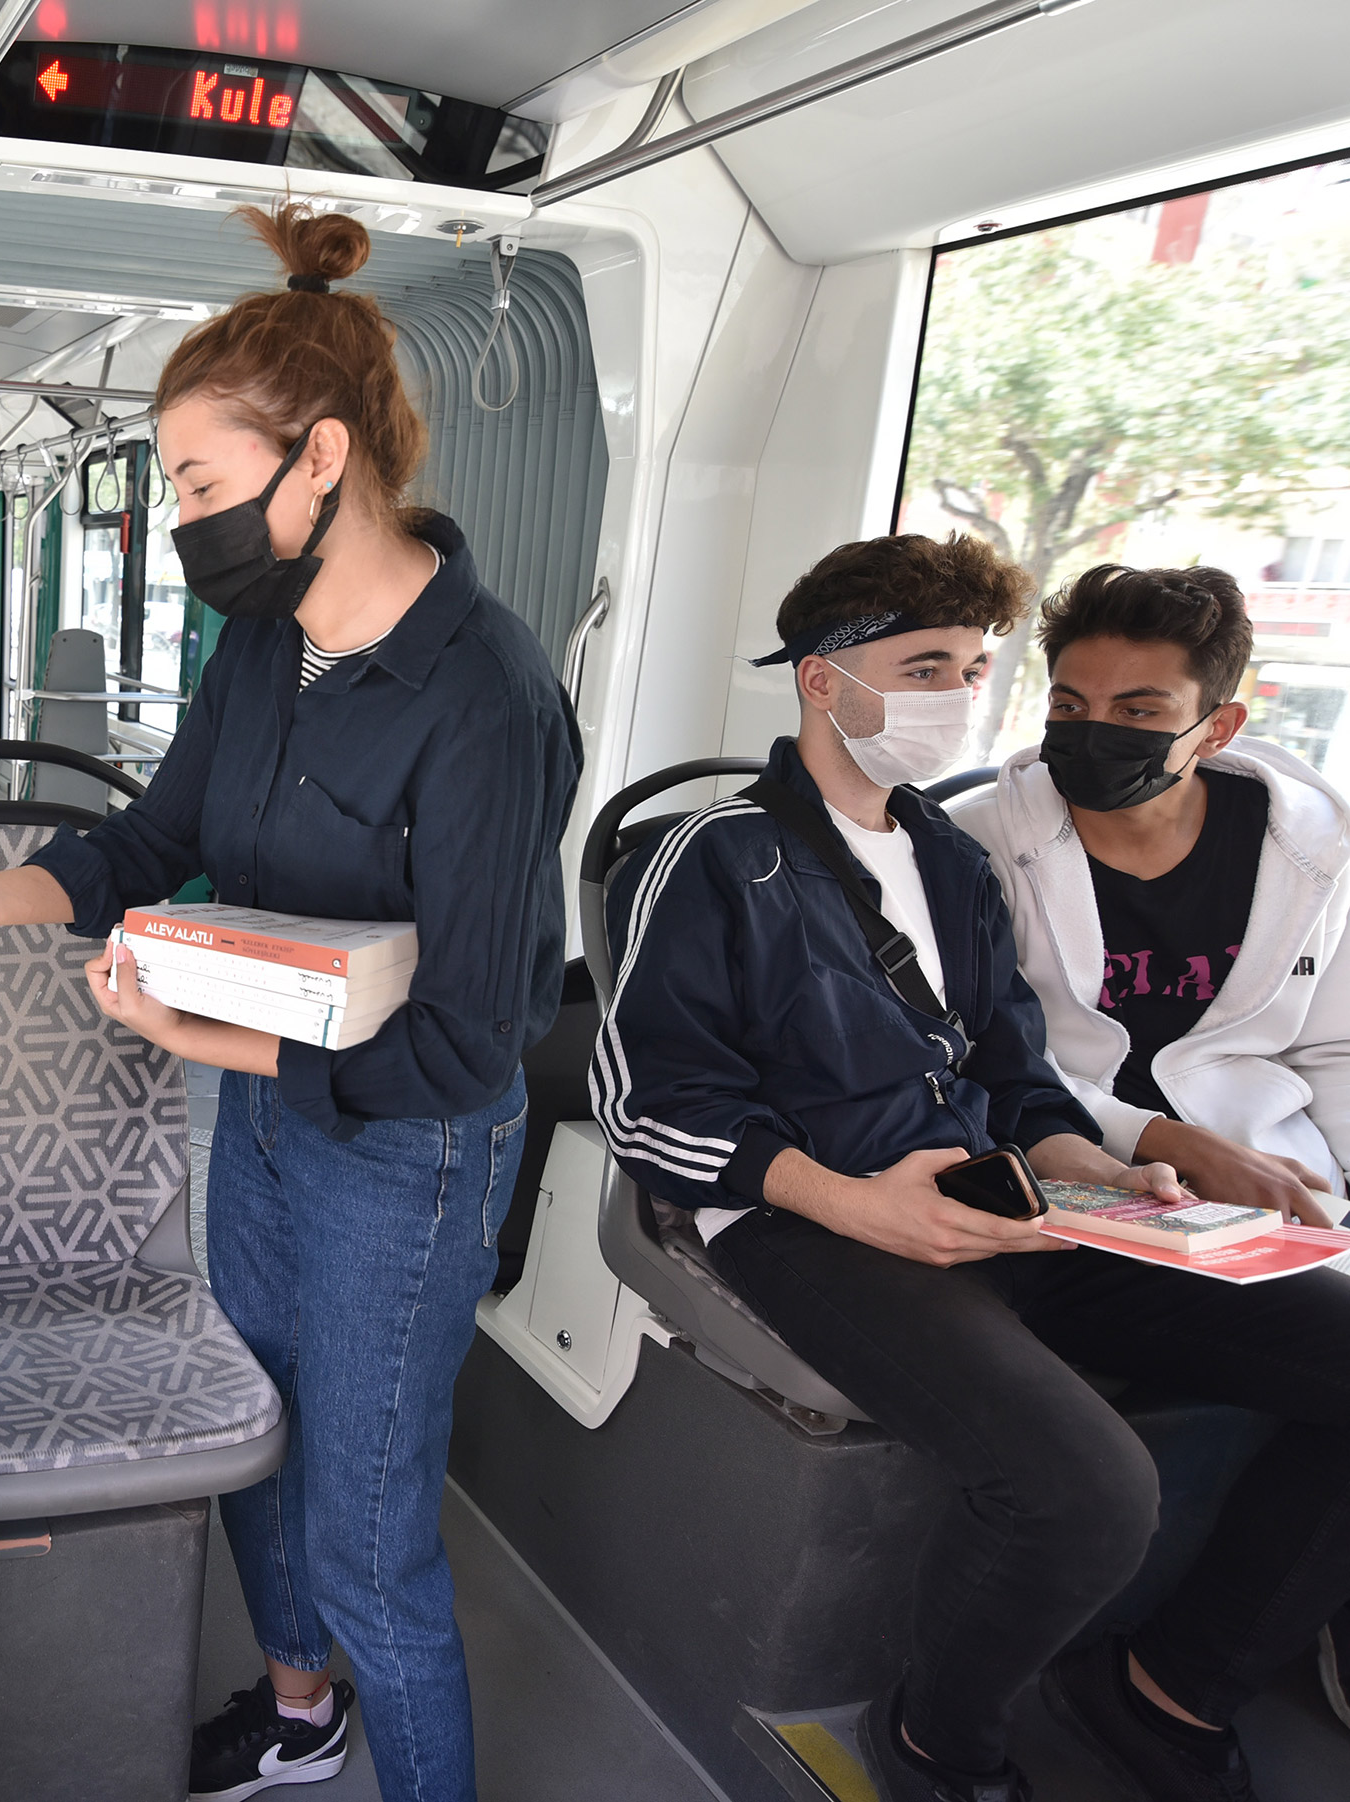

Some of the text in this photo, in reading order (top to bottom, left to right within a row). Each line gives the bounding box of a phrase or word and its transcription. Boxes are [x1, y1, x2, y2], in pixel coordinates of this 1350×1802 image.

[191, 71, 292, 128] Kule
[144, 921, 214, 945] ALEV ALATLI
